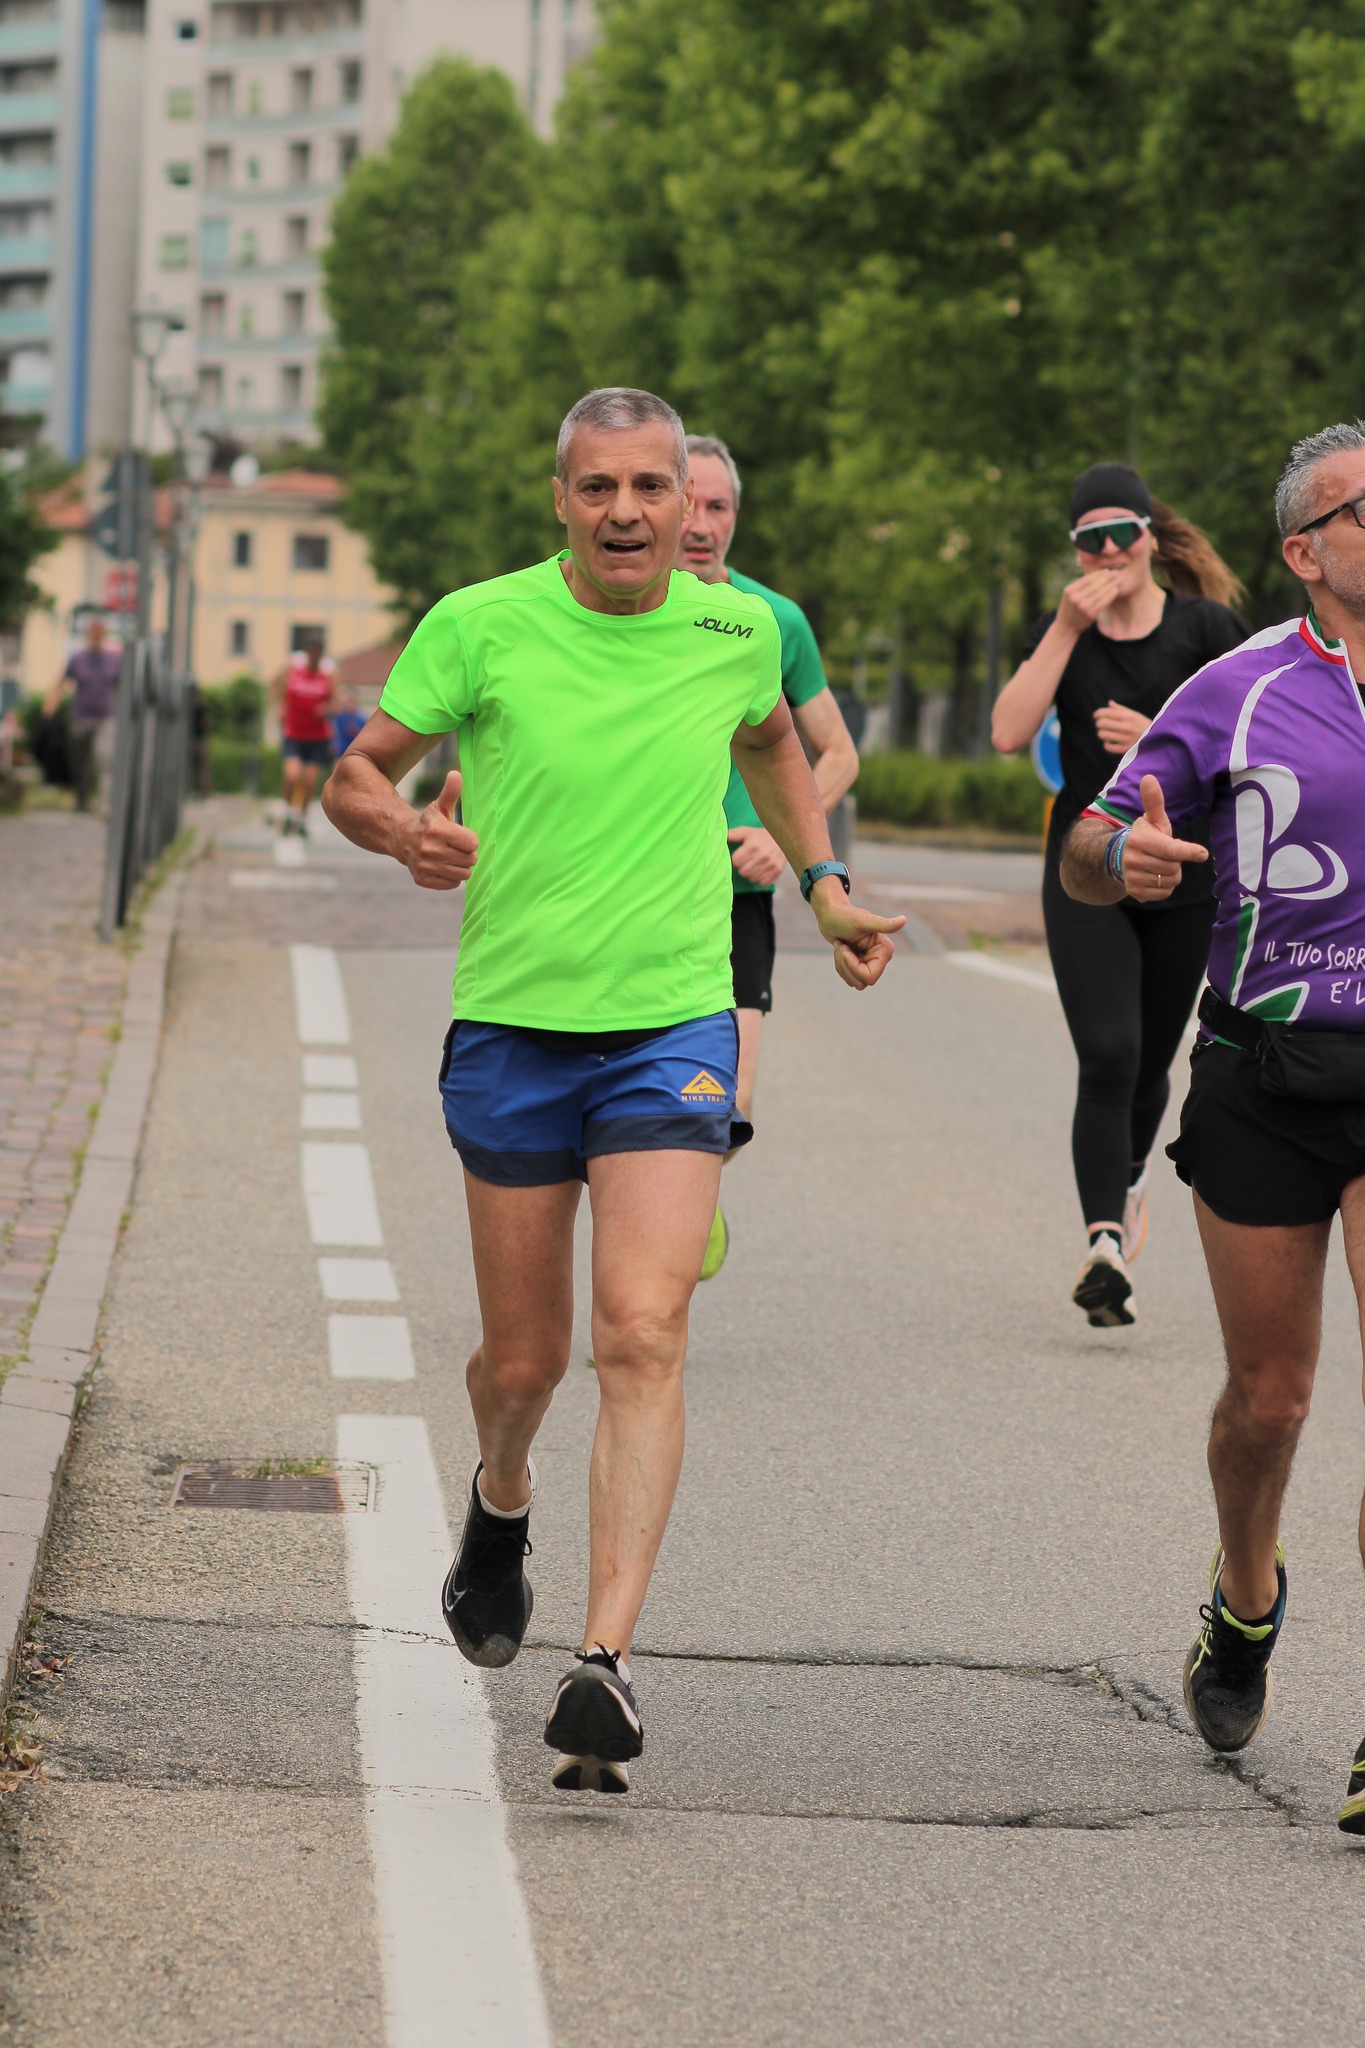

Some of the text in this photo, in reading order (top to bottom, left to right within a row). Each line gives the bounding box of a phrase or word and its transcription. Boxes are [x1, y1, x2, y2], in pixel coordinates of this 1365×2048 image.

[693, 616, 754, 639] JOLUVI
[1264, 941, 1280, 962] IL
[1286, 942, 1322, 967] TUO
